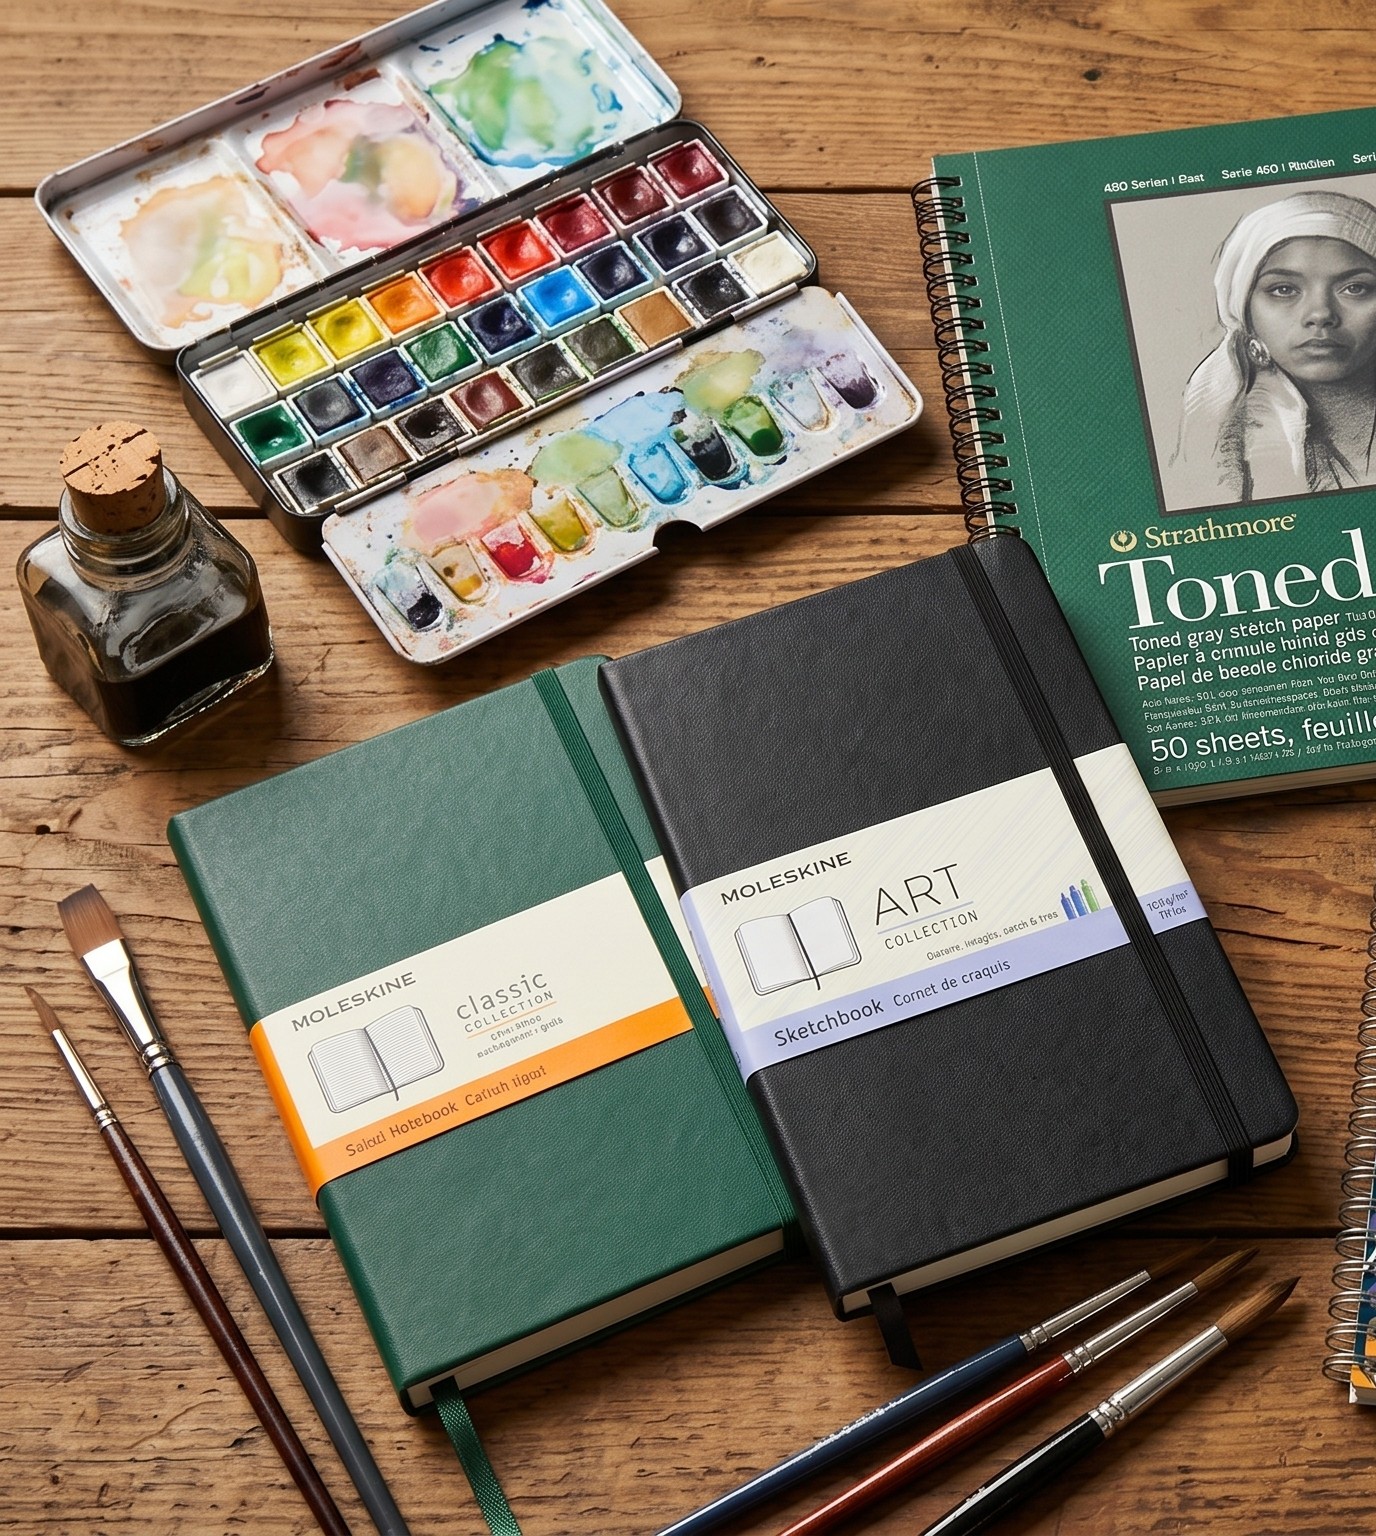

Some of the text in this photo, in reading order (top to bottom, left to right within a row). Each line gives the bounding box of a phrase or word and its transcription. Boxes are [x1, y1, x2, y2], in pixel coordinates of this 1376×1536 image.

[1129, 631, 1182, 652] Toned
[1188, 629, 1224, 649] gray
[1292, 612, 1340, 633] paper
[1137, 670, 1186, 692] Papel
[1192, 667, 1214, 684] de
[1151, 736, 1188, 762] 50
[1196, 725, 1294, 756] sheets,
[721, 851, 852, 906] MOLESKINE
[875, 863, 958, 926] ART
[885, 910, 979, 950] COLLECTION
[291, 972, 417, 1032] MOLESKINE
[457, 973, 547, 1020] classic
[464, 990, 553, 1033] COLLECTION
[774, 999, 885, 1047] Sketchbook
[941, 977, 958, 991] de
